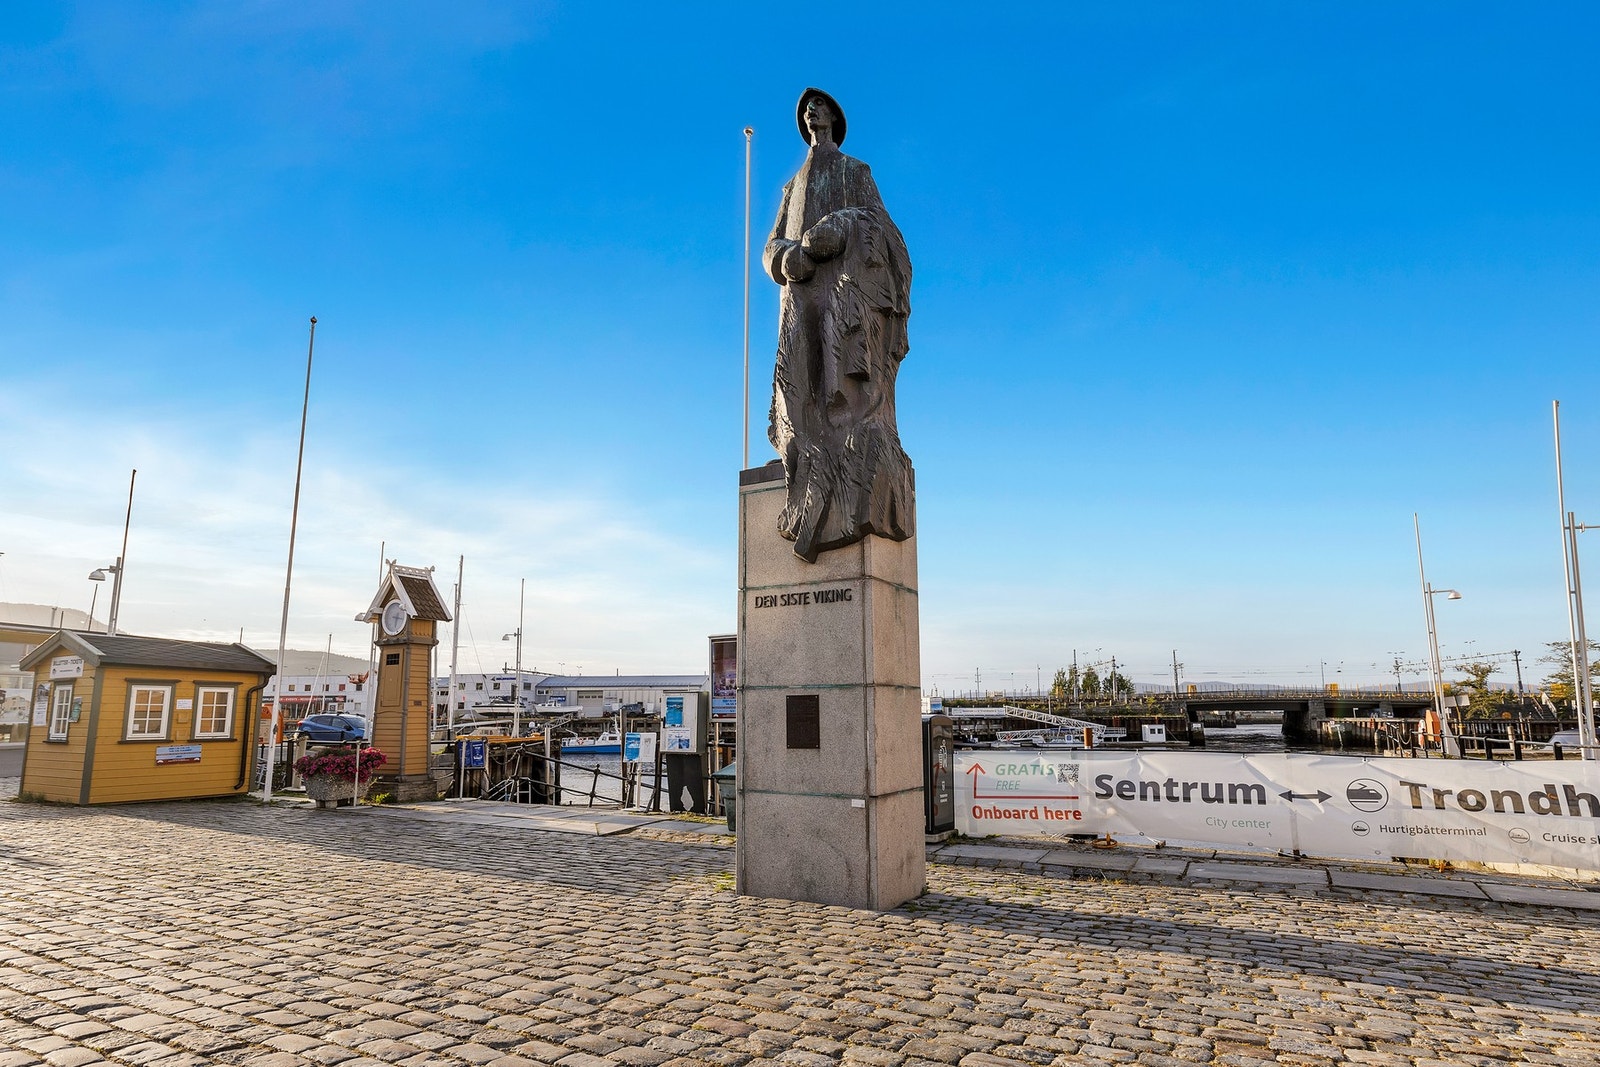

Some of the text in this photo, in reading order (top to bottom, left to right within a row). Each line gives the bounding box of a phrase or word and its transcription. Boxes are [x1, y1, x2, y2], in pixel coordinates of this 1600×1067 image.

[755, 588, 852, 608] DEN SISTE VIKING
[995, 763, 1055, 776] GRATIS
[995, 780, 1021, 790] FREE
[1094, 773, 1267, 805] Sentrum
[1399, 780, 1600, 818] Trondh
[972, 805, 1082, 820] Onboard here
[1205, 816, 1271, 829] City center
[1379, 824, 1487, 837] Hurtigbåtterminal
[1542, 832, 1586, 844] Cruise
